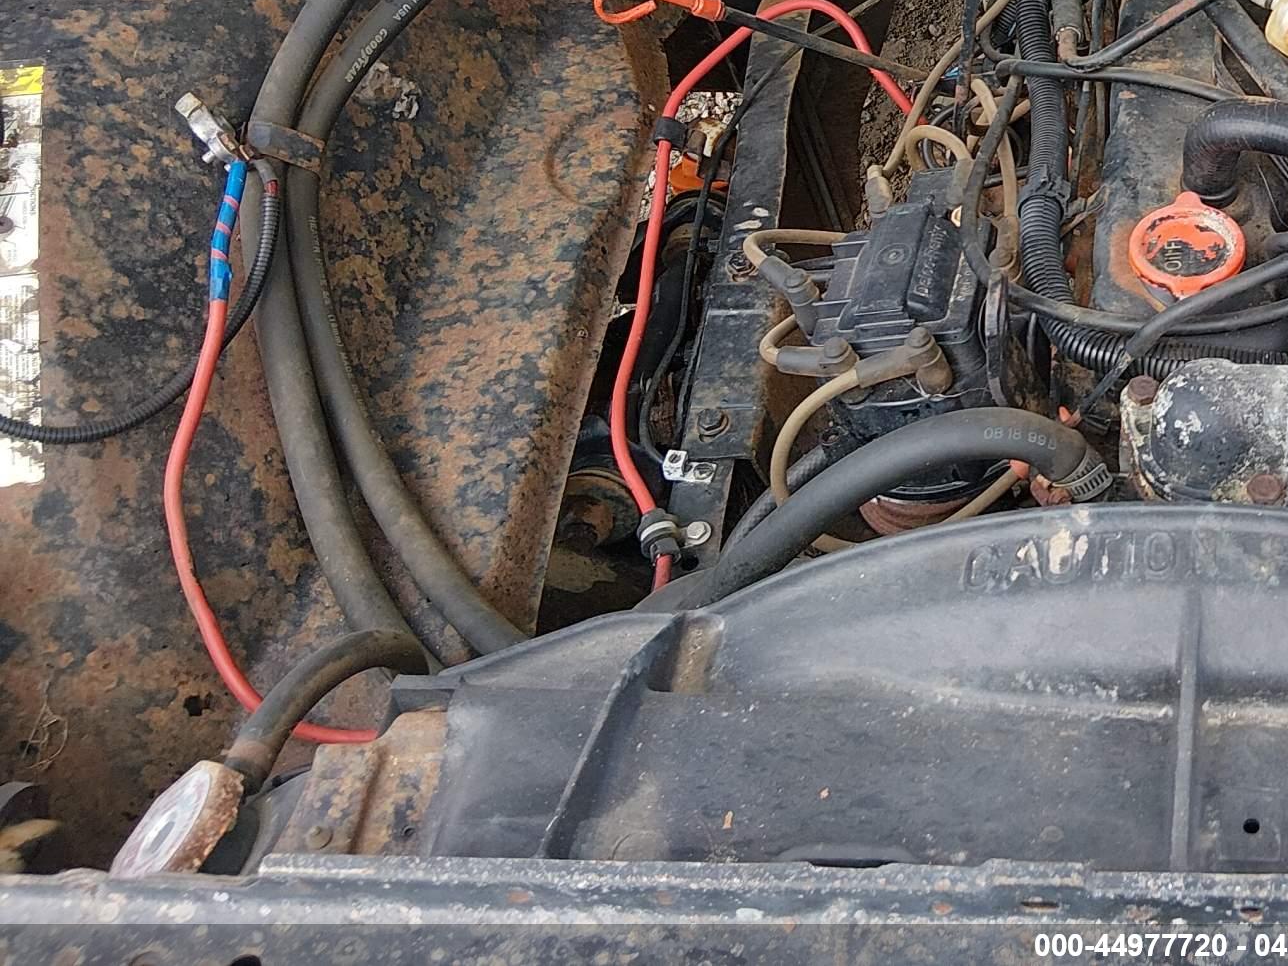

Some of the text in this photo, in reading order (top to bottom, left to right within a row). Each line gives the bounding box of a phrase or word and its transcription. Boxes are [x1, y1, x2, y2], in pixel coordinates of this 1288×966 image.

[393, 3, 412, 21] USA
[344, 28, 388, 83] GOODYEAR
[960, 528, 1221, 592] CAUTION
